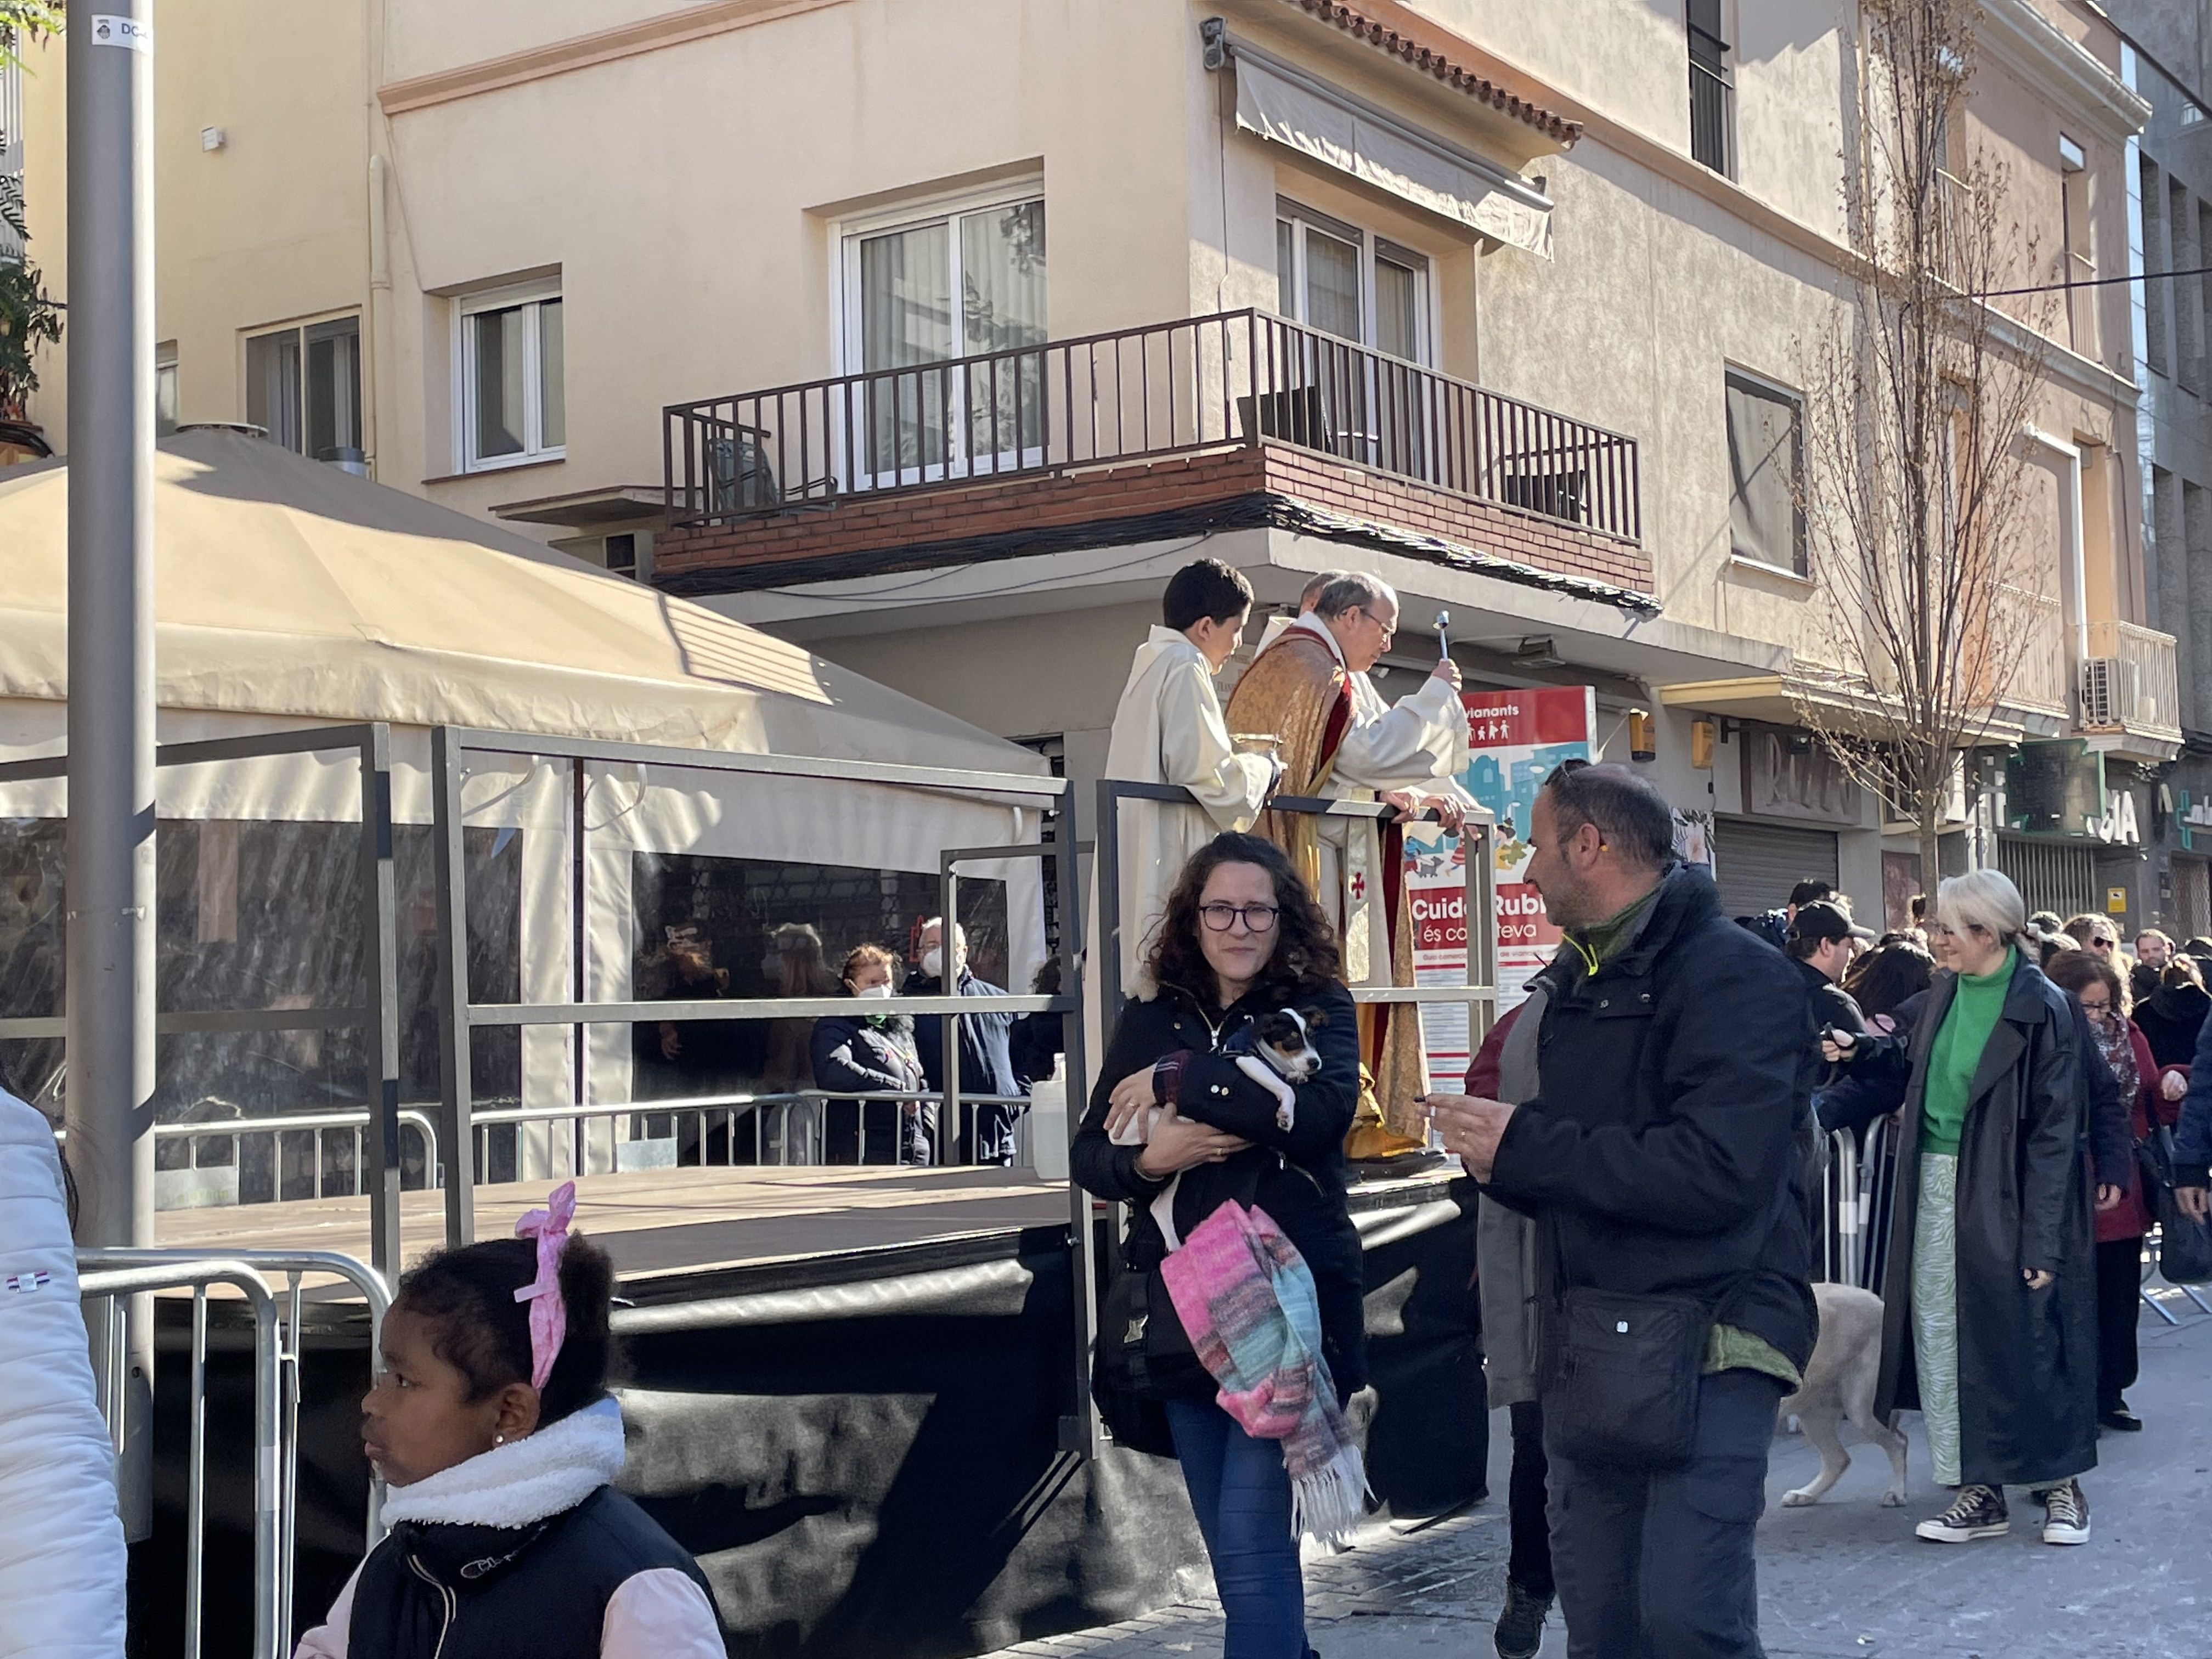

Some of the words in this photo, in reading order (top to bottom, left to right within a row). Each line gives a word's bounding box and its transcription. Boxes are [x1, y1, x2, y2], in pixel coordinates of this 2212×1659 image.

[1412, 896, 1467, 921] Cuid
[1424, 924, 1441, 942] és
[1497, 922, 1536, 938] teva
